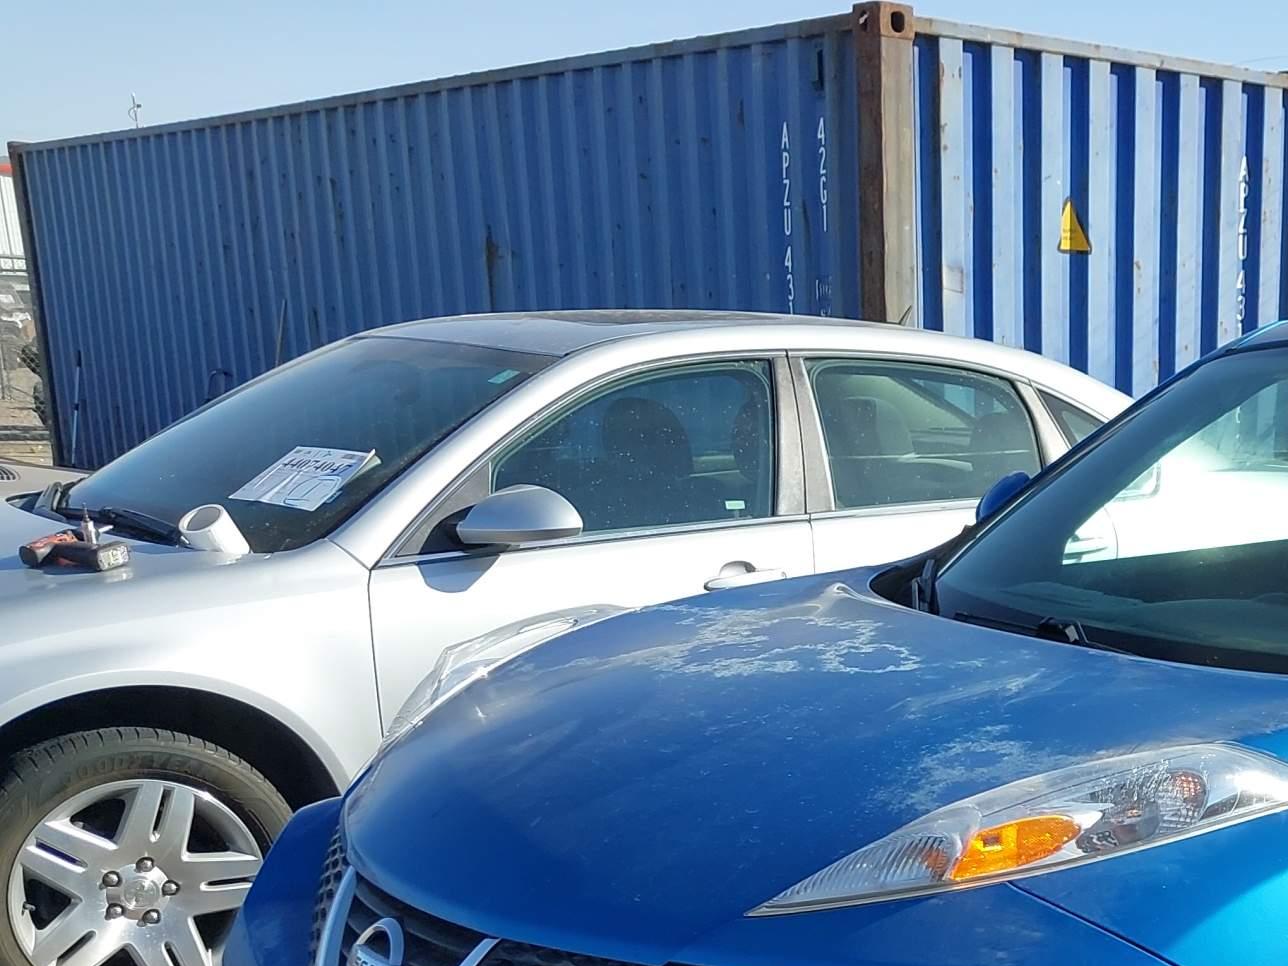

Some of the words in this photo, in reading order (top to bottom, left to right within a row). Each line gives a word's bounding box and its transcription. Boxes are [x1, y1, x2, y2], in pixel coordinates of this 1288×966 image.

[781, 121, 792, 236] APZU
[817, 116, 828, 232] 42G1
[1238, 155, 1249, 260] APZU
